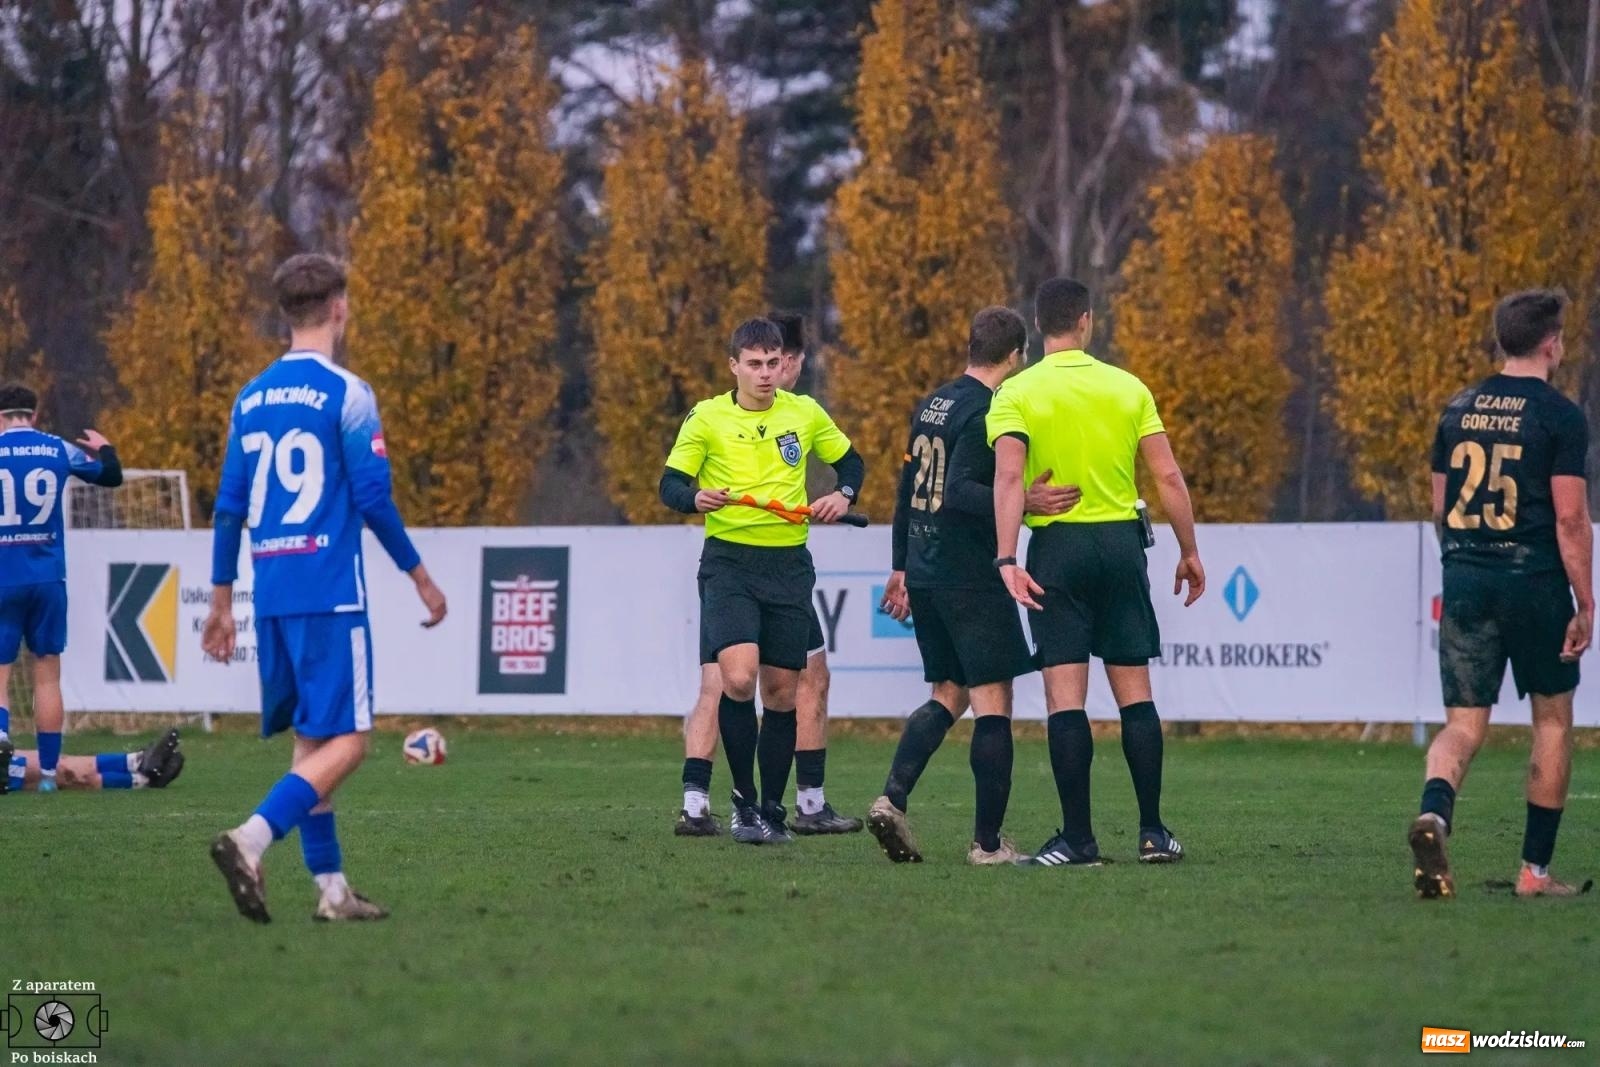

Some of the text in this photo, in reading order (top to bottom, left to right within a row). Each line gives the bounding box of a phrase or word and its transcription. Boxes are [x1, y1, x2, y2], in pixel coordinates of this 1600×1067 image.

[265, 384, 328, 411] RACIBÓRZ
[1475, 395, 1526, 410] CZARNI
[1461, 413, 1522, 432] GORZYCE
[12, 443, 59, 458] RACIBÓRZ
[241, 427, 325, 528] 79
[911, 434, 945, 513] 20
[1447, 440, 1523, 530] 25
[0, 467, 57, 526] 19
[492, 592, 558, 622] BEEF
[491, 624, 556, 653] BROS
[1152, 642, 1214, 667] UPRA
